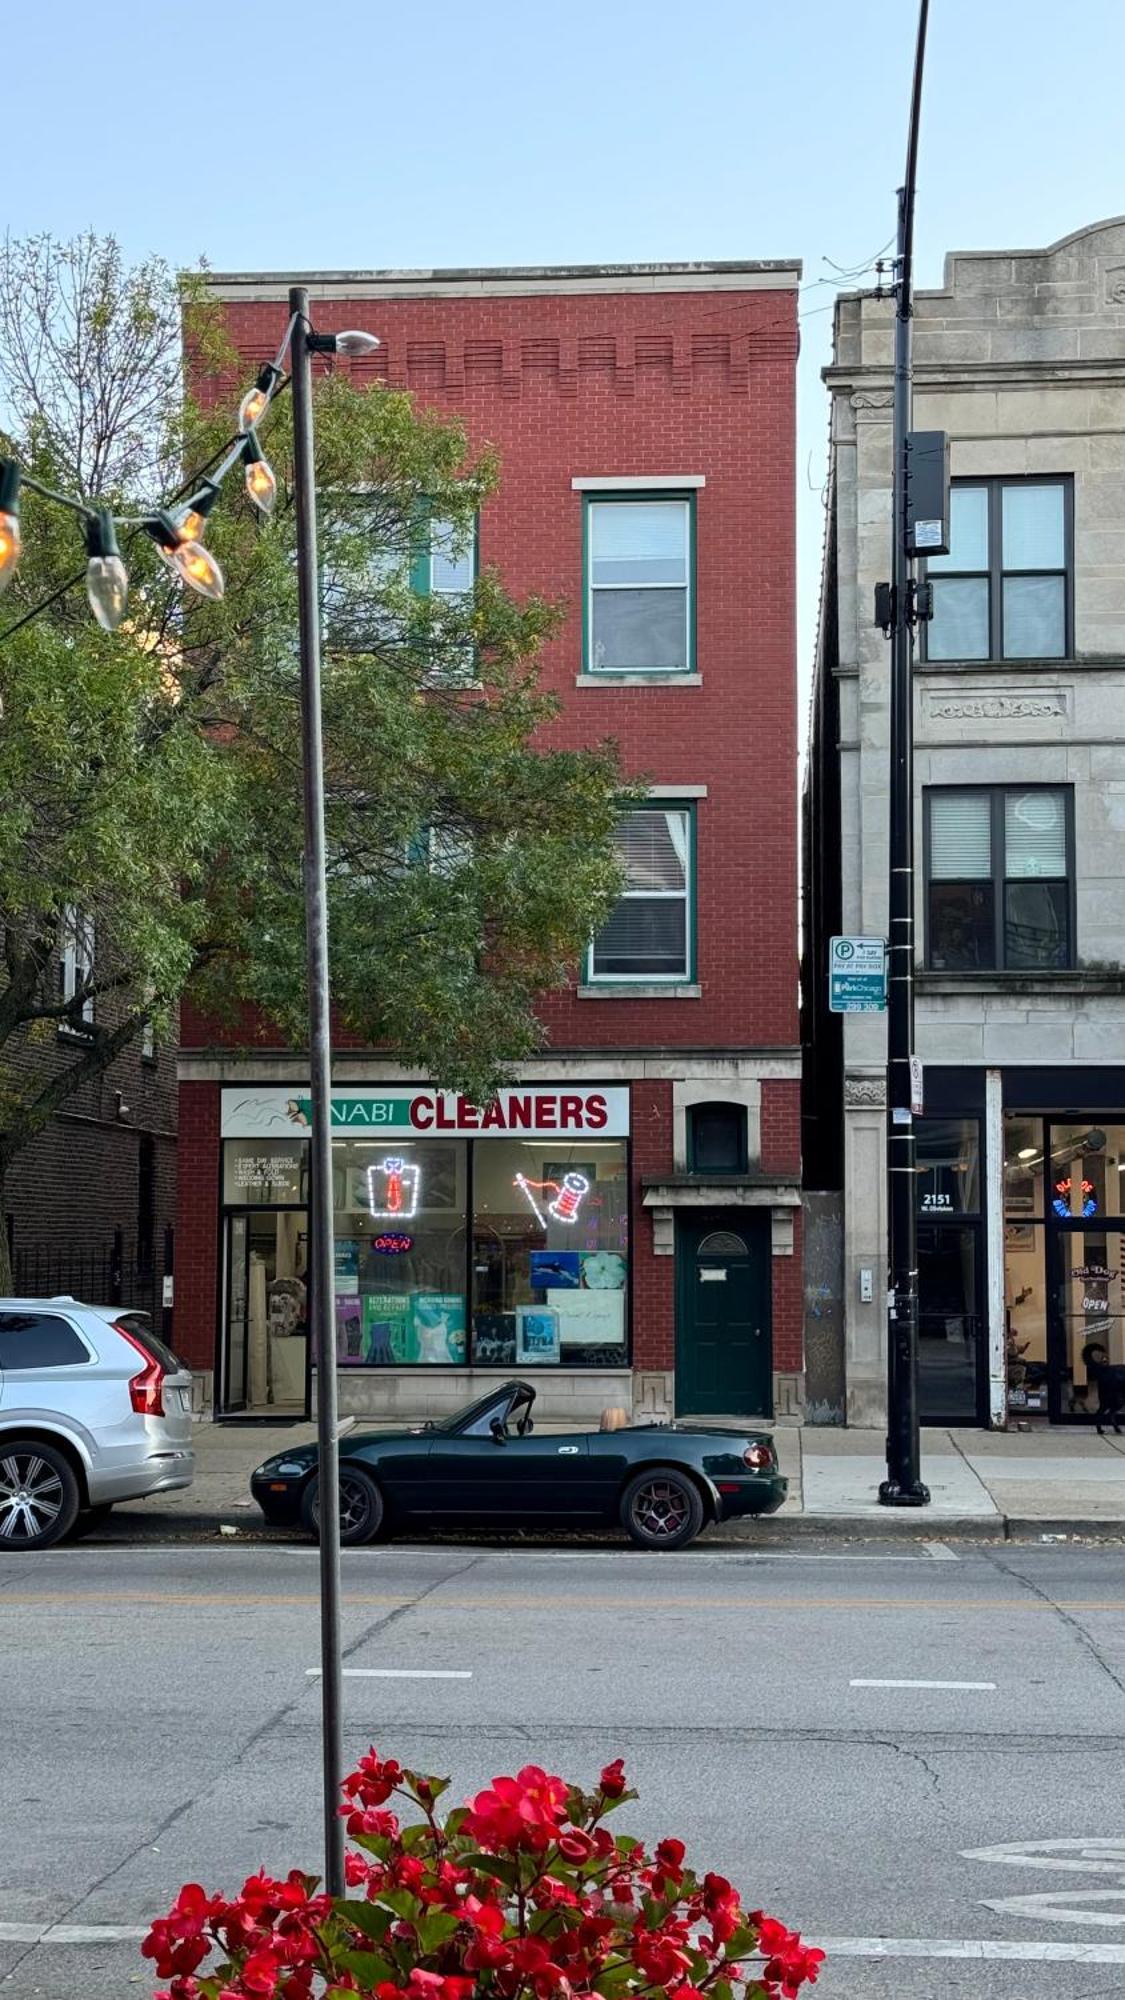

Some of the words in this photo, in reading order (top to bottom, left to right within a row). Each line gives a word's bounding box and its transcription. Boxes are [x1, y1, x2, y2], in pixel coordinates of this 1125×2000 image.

[330, 1103, 394, 1122] NABI
[410, 1094, 608, 1130] CLEANERS
[923, 1194, 950, 1205] 2151
[374, 1238, 411, 1250] OPEN
[1071, 1266, 1090, 1276] Old
[1092, 1265, 1115, 1279] Dog
[1082, 1296, 1109, 1311] OPEN
